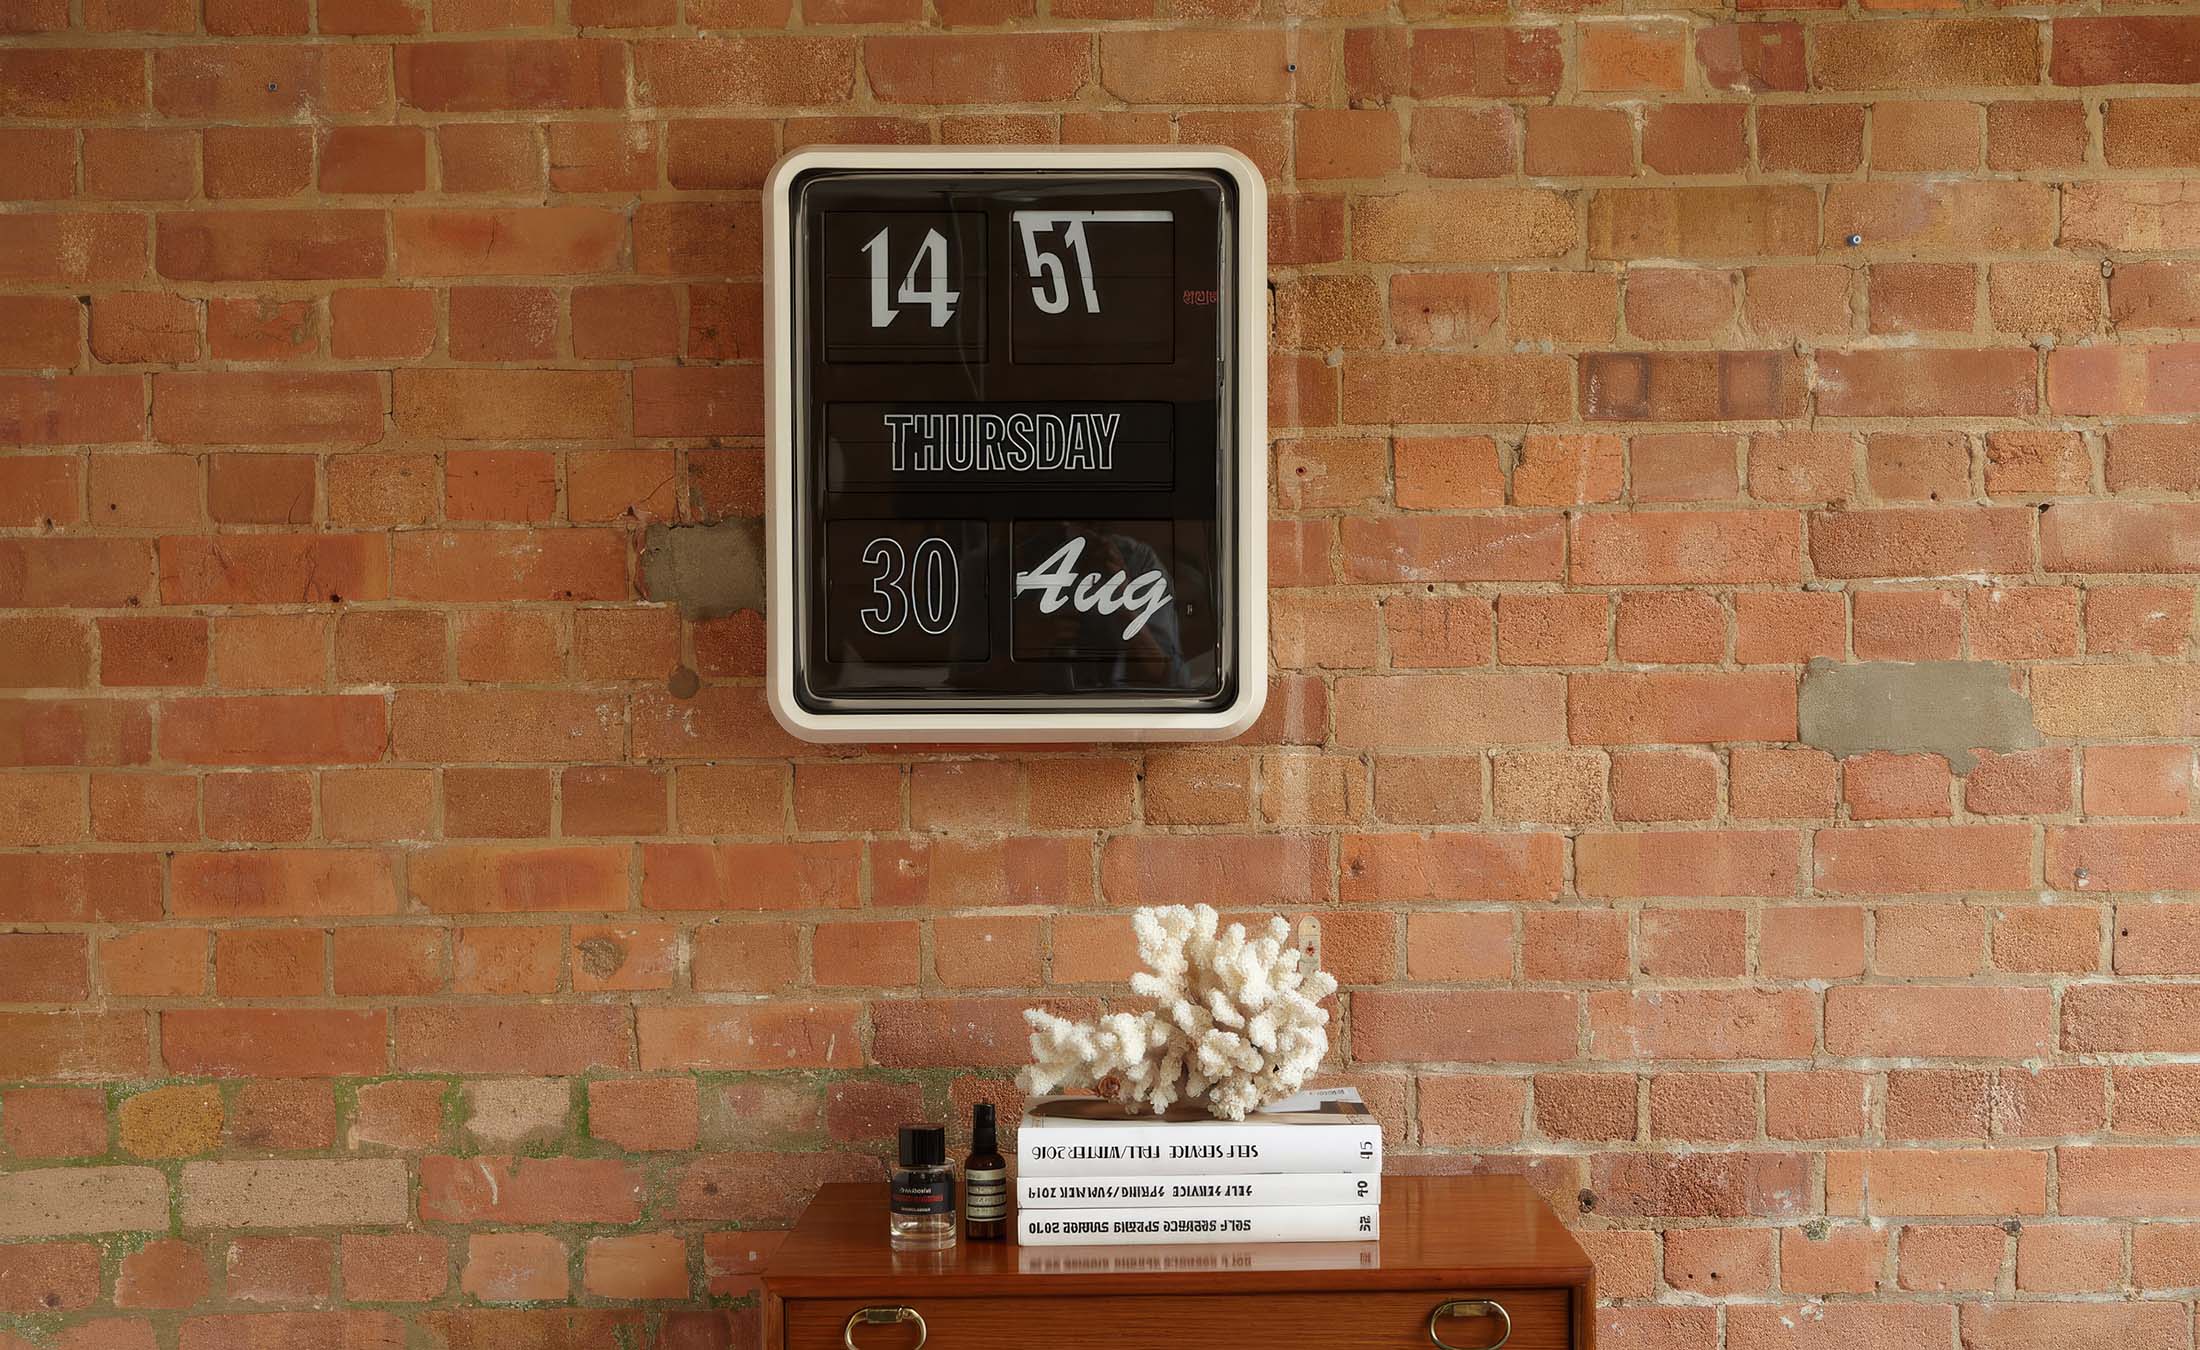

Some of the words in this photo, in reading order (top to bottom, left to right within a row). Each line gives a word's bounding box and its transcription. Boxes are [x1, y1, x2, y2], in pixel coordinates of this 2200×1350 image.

[862, 227, 961, 328] 14
[1018, 216, 1101, 314] 51
[884, 413, 1121, 472] THURSDAY
[860, 537, 960, 635] 30
[1016, 536, 1173, 641] Aug
[1031, 1145, 1066, 1160] 2016
[1067, 1145, 1160, 1160] FALL/WINTER
[1169, 1144, 1223, 1159] SERVICE
[1226, 1144, 1259, 1158] SELF
[1359, 1141, 1374, 1160] 45
[1028, 1187, 1057, 1199] 2014
[1172, 1185, 1222, 1198] SERVICE
[1224, 1185, 1253, 1197] SELF
[1028, 1221, 1060, 1235] 2010
[1220, 1219, 1252, 1232] SELF
